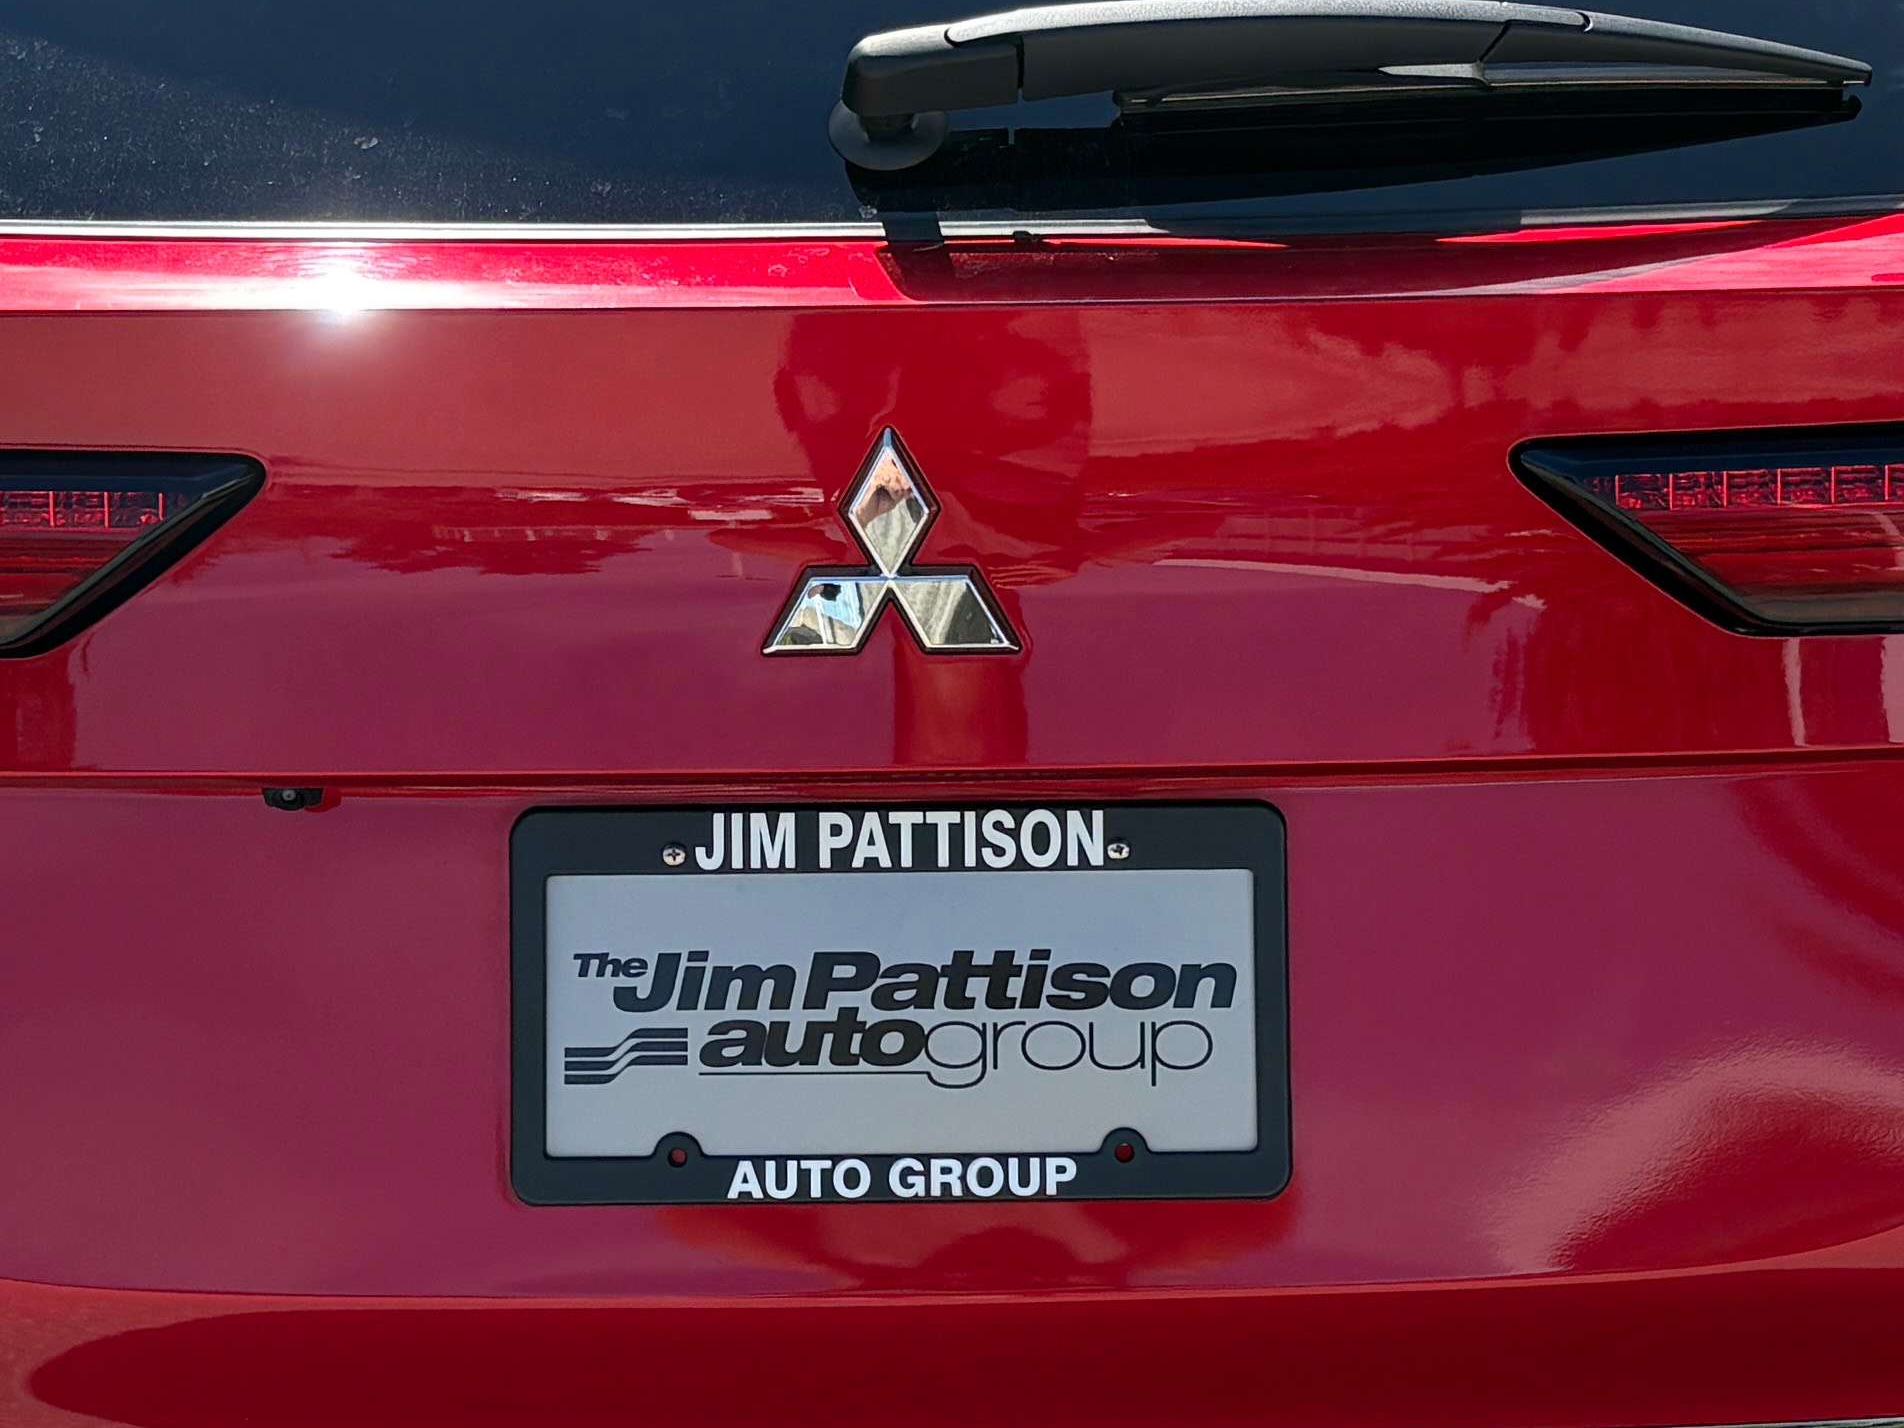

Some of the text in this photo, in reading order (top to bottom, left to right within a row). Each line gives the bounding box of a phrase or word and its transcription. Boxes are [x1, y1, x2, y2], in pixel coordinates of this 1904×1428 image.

[695, 808, 1105, 870] JIM PATTISON
[572, 952, 648, 978] The
[727, 1157, 1077, 1200] AUTO GROUP
